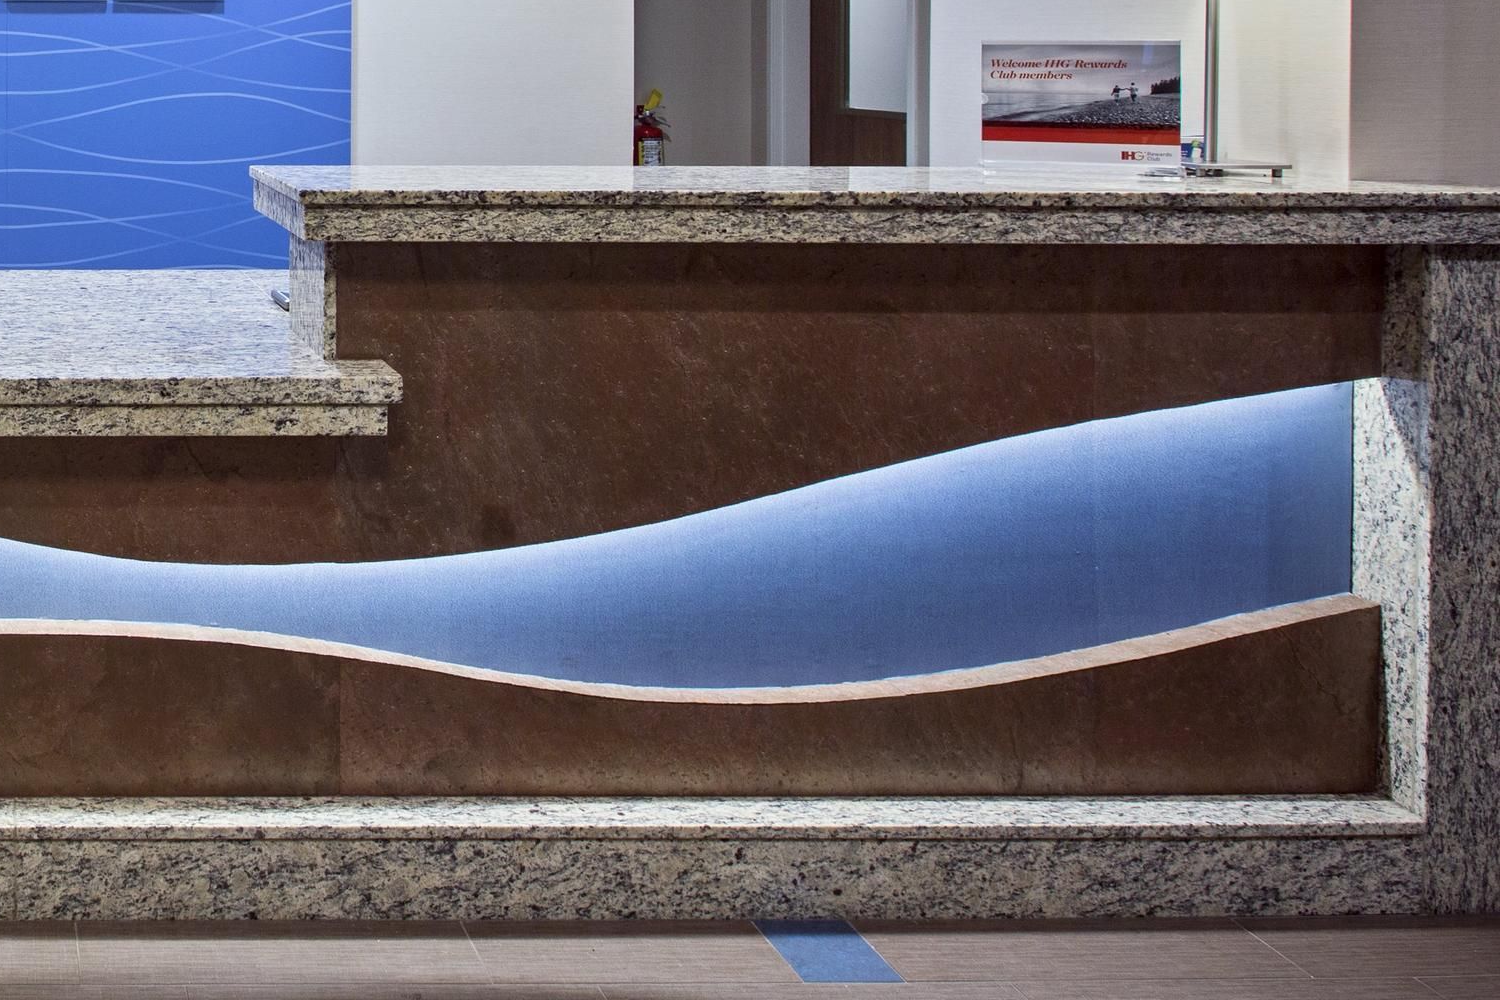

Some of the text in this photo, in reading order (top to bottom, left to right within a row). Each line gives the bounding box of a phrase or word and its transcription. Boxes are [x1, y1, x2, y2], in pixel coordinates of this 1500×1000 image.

[991, 59, 1128, 69] Welcome IHG Rewards
[990, 70, 1073, 80] Club members
[1121, 151, 1145, 161] IHG
